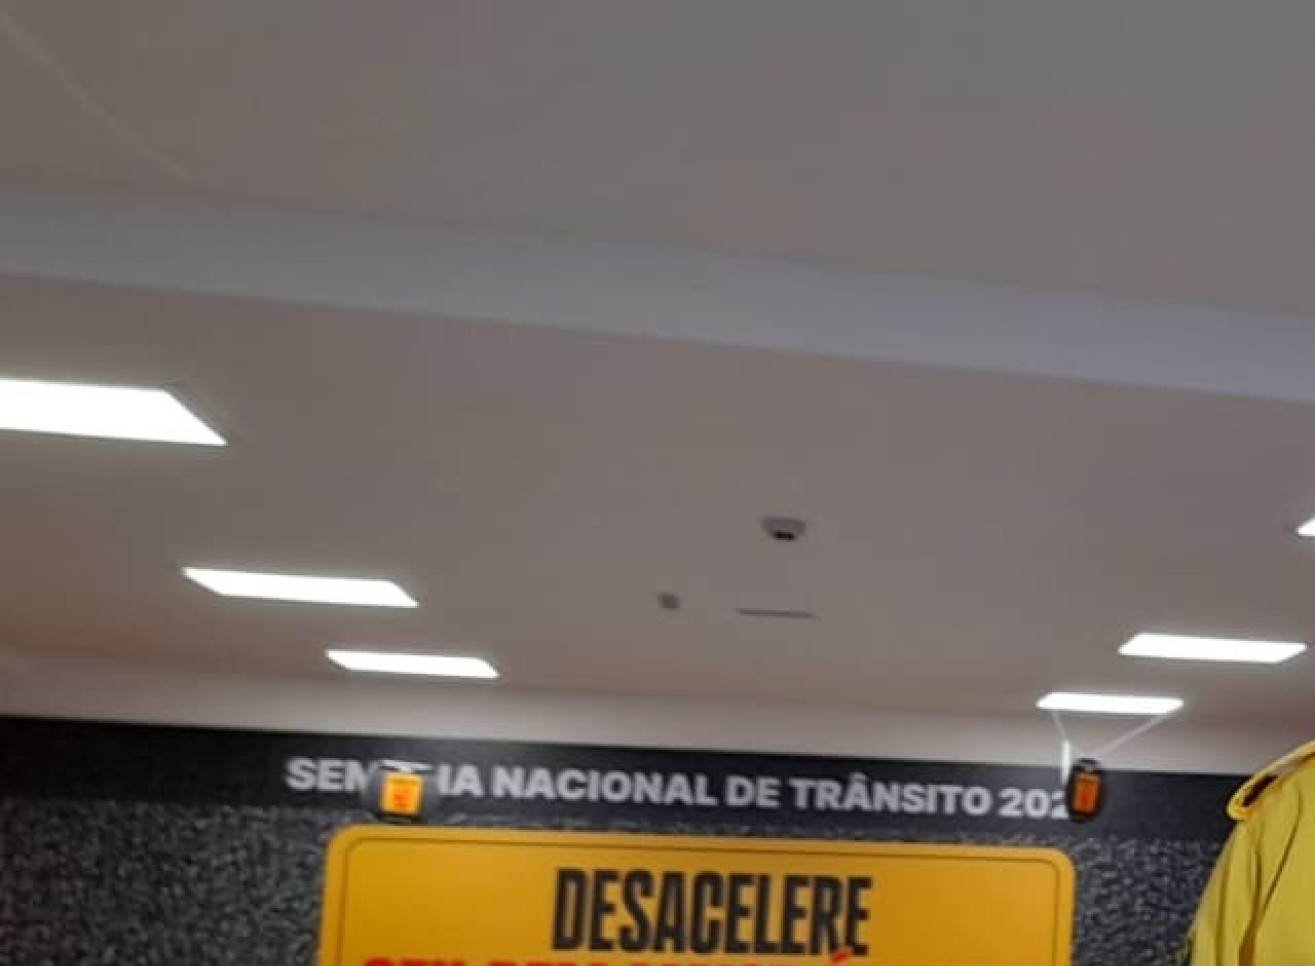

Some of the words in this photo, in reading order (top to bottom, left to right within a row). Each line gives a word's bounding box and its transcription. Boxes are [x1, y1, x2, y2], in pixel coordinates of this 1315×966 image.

[286, 756, 483, 797] SEMA
[493, 765, 718, 807] NACIONAL
[725, 774, 779, 808] DE
[789, 772, 993, 816] TRÂNSITO
[998, 787, 1069, 819] 202
[552, 867, 873, 957] DESACELERE
